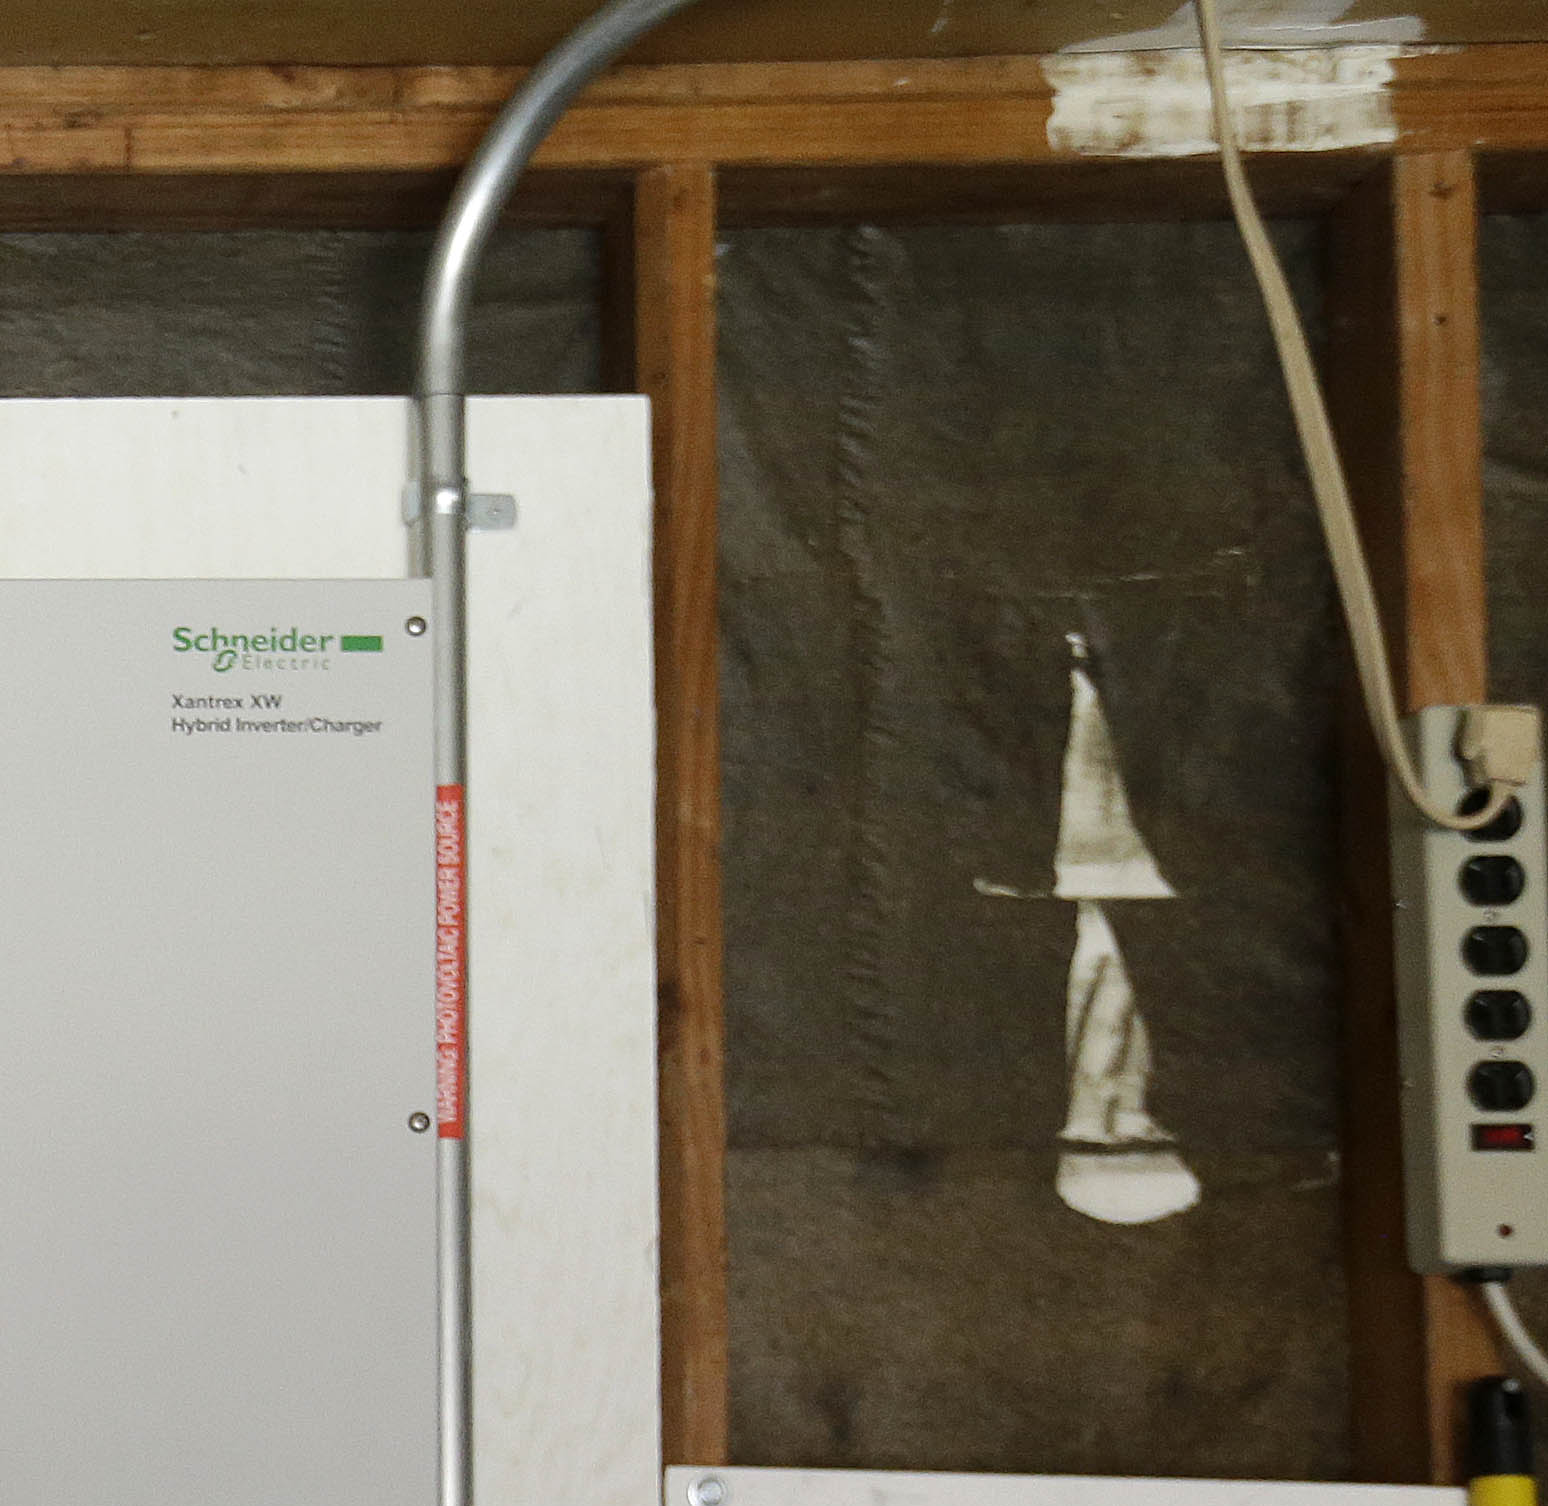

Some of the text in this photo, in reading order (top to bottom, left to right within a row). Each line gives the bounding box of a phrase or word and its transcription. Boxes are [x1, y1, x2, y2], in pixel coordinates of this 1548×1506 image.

[172, 626, 335, 652] Schneider
[243, 654, 330, 670] Electric
[172, 694, 282, 709] Xantrex XW
[172, 717, 231, 735] Hybrid
